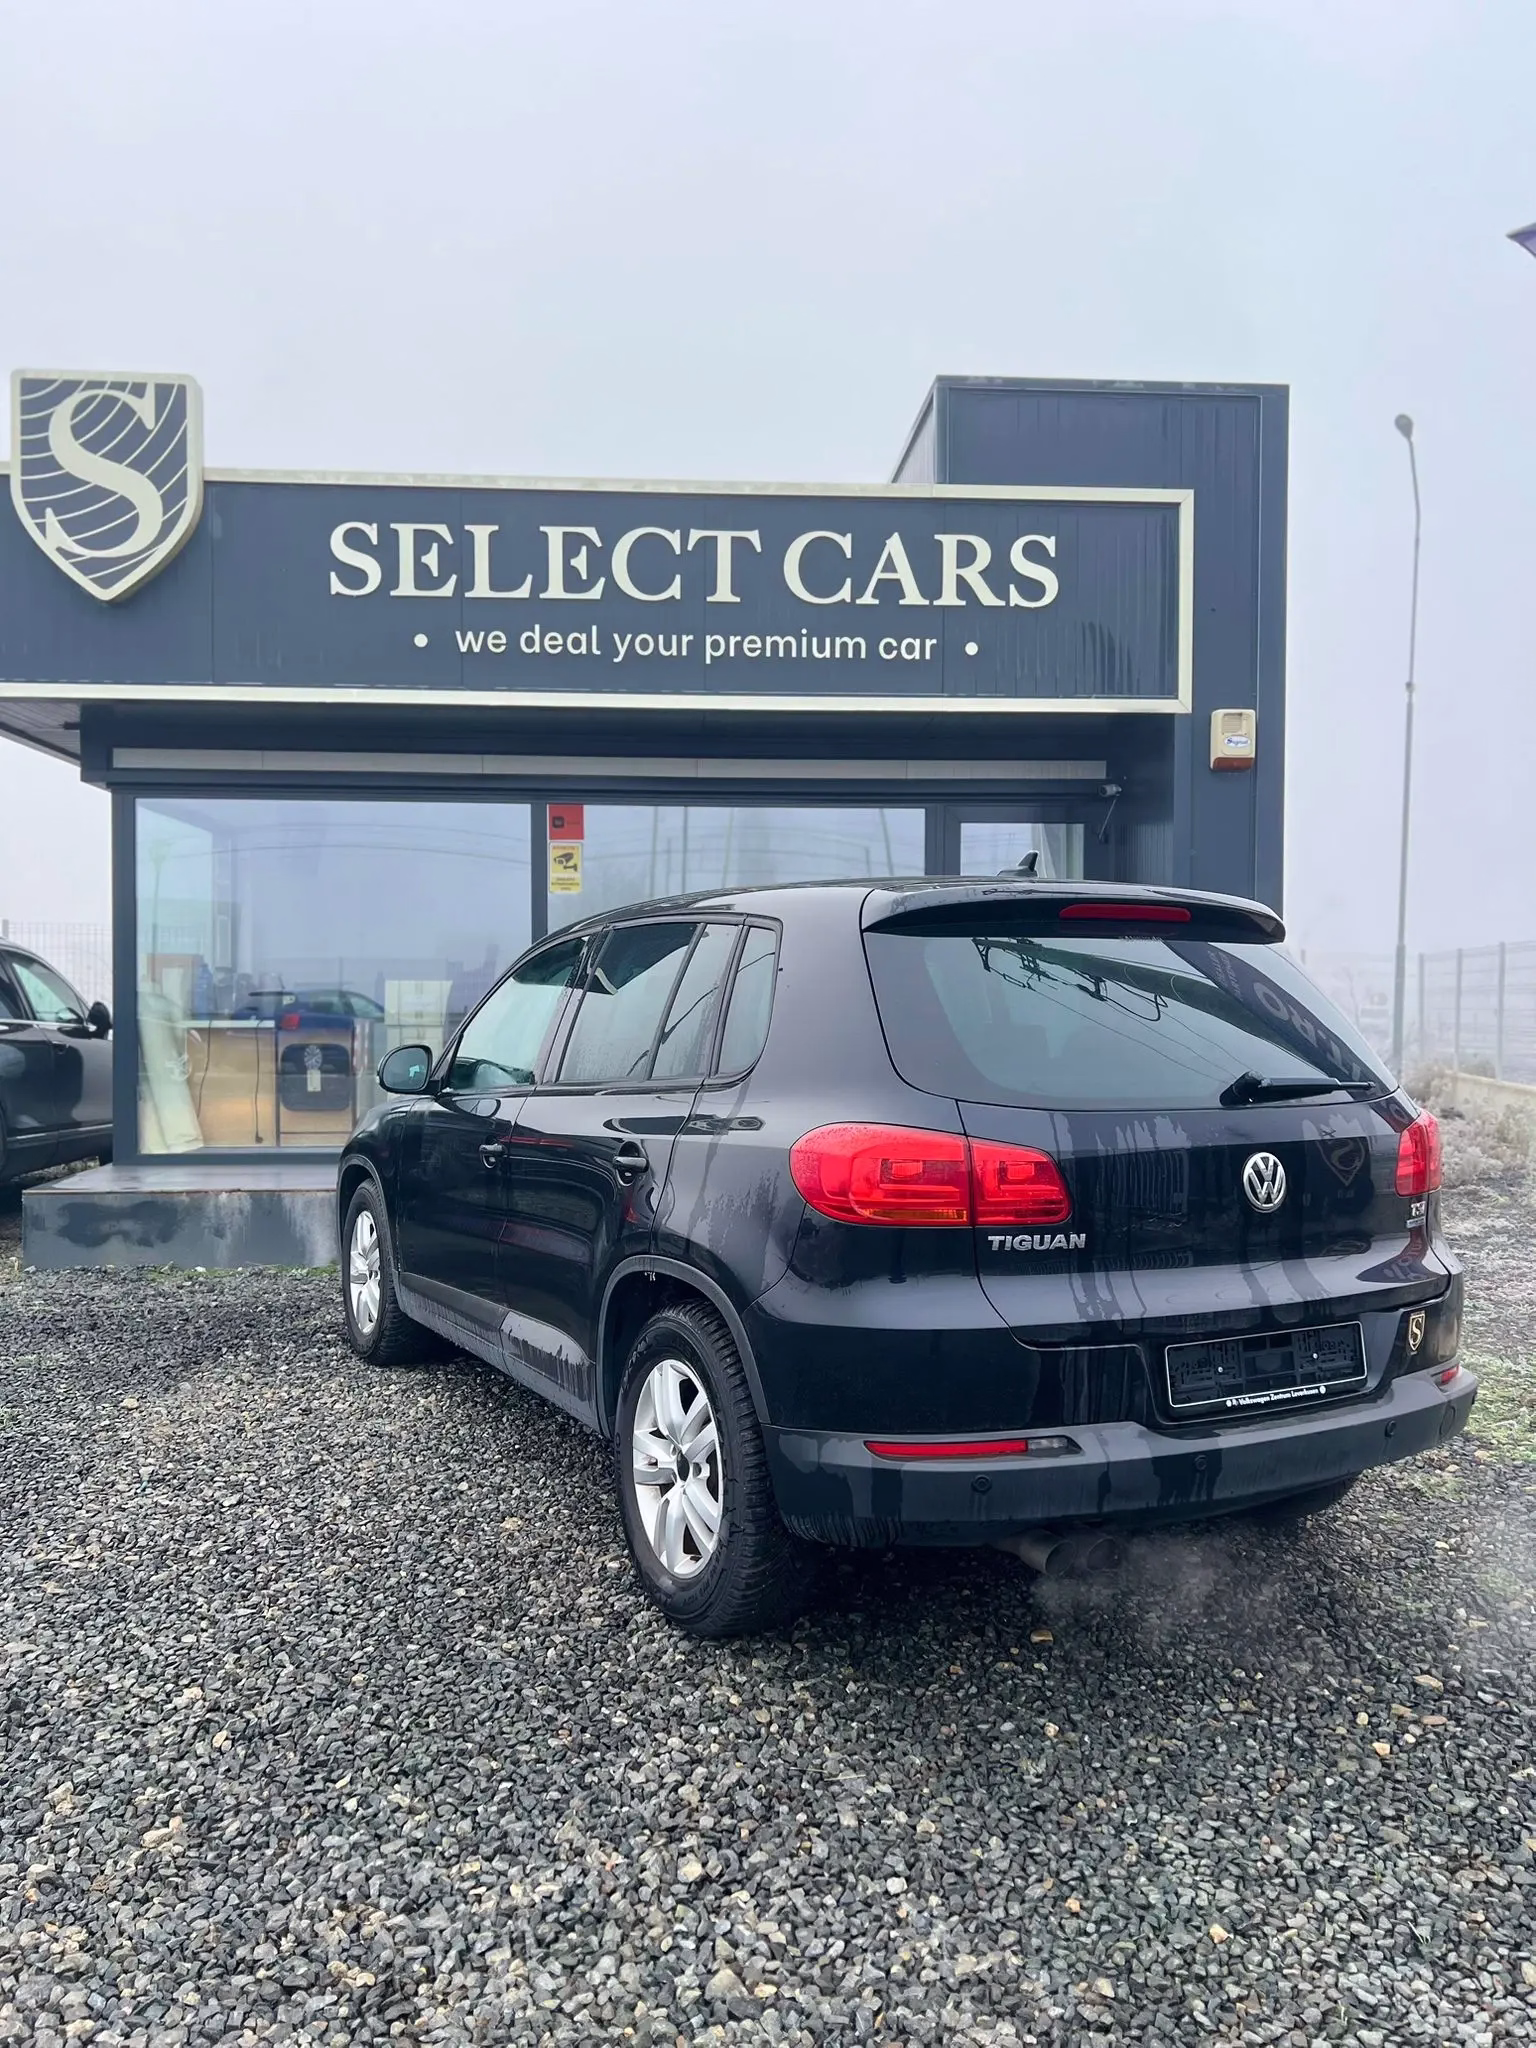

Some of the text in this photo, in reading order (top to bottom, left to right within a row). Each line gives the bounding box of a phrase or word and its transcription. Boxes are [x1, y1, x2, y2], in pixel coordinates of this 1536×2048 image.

[46, 388, 163, 558] S
[329, 521, 1059, 608] SELECT CARS
[455, 623, 938, 665] we deal your premium car
[1245, 1154, 1285, 1208] VW
[987, 1233, 1086, 1251] TIGUAN
[1238, 1397, 1271, 1406] Volkswagen
